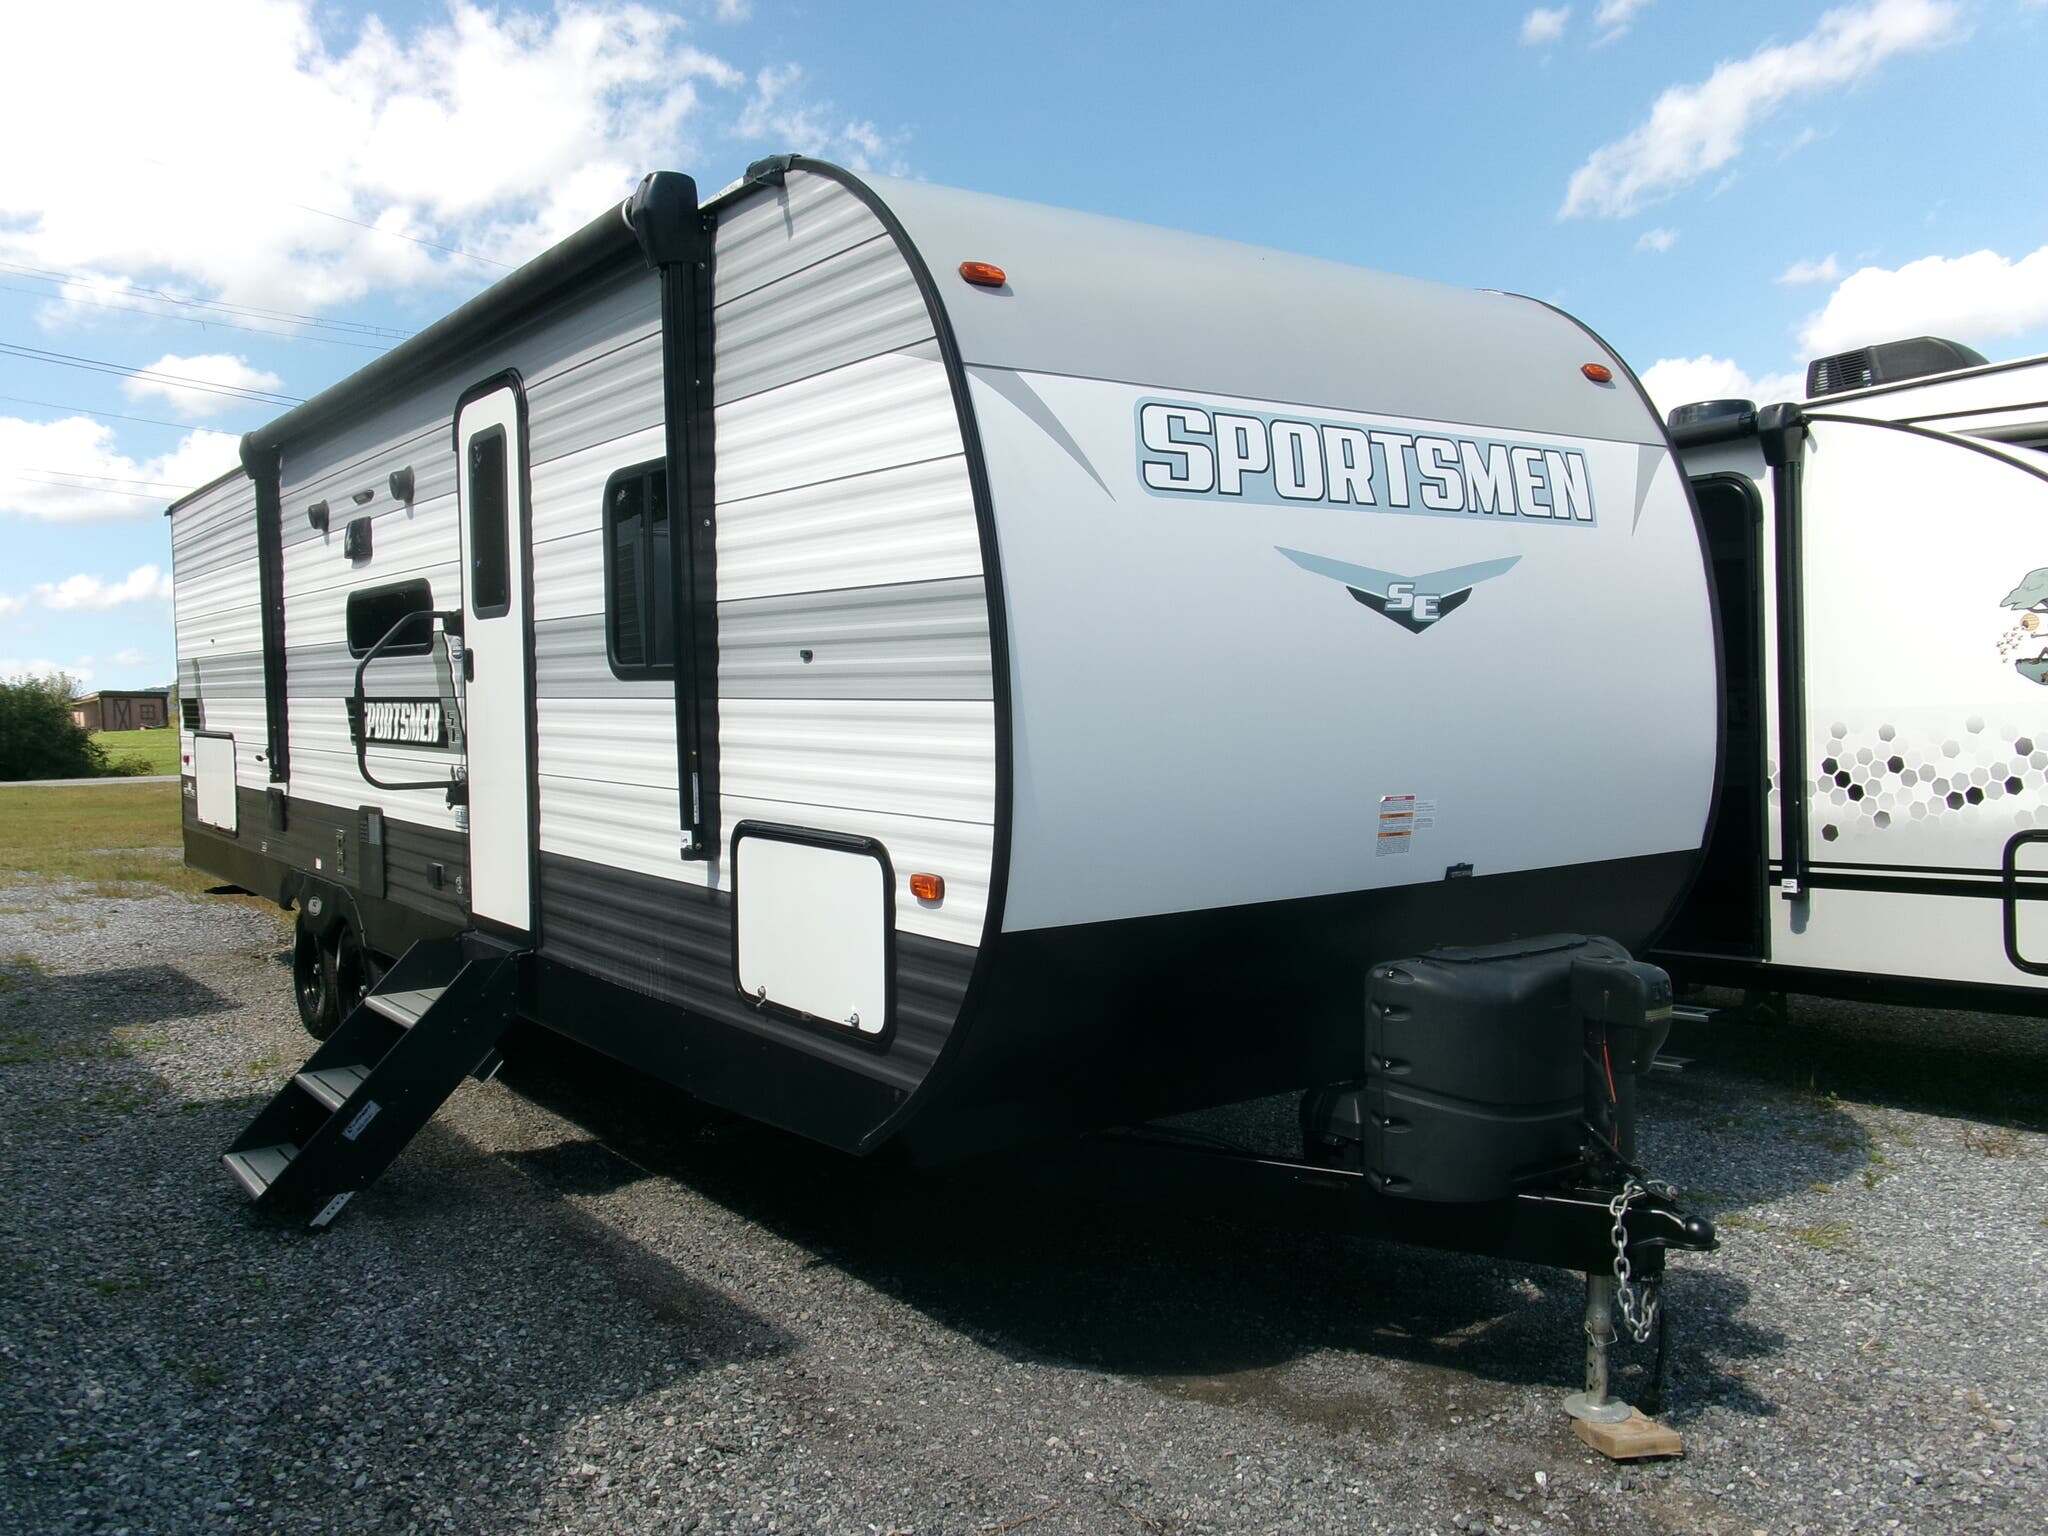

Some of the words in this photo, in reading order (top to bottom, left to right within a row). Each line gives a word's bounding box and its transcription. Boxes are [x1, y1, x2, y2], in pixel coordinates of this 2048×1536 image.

[1140, 402, 1594, 522] SPORTSMEN
[1385, 582, 1441, 622] SE
[364, 702, 440, 743] PORTSMEN
